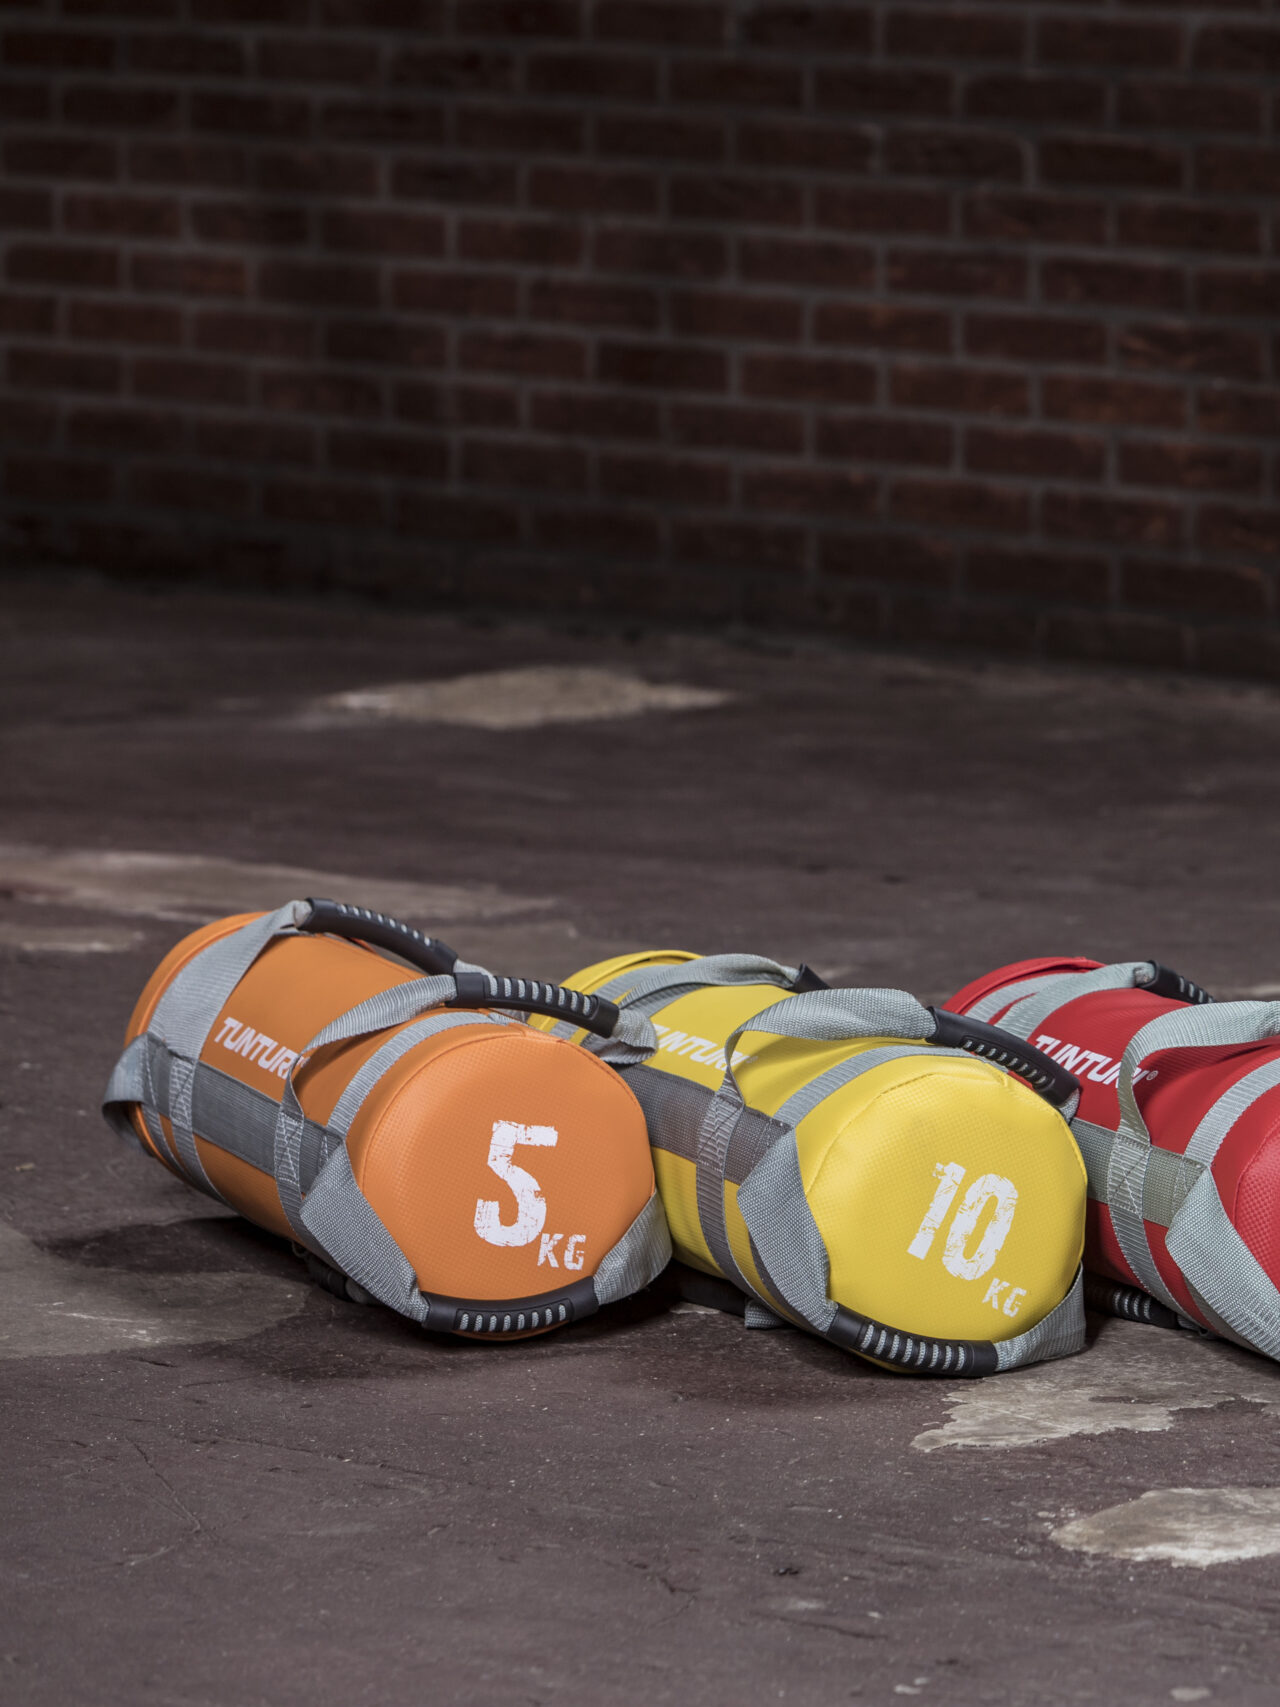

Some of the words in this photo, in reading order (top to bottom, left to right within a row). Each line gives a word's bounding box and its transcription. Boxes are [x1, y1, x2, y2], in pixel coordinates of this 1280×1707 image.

[474, 1120, 558, 1247] 5
[537, 1233, 586, 1270] KG
[907, 1161, 1018, 1281] 10
[982, 1278, 1027, 1318] KG
